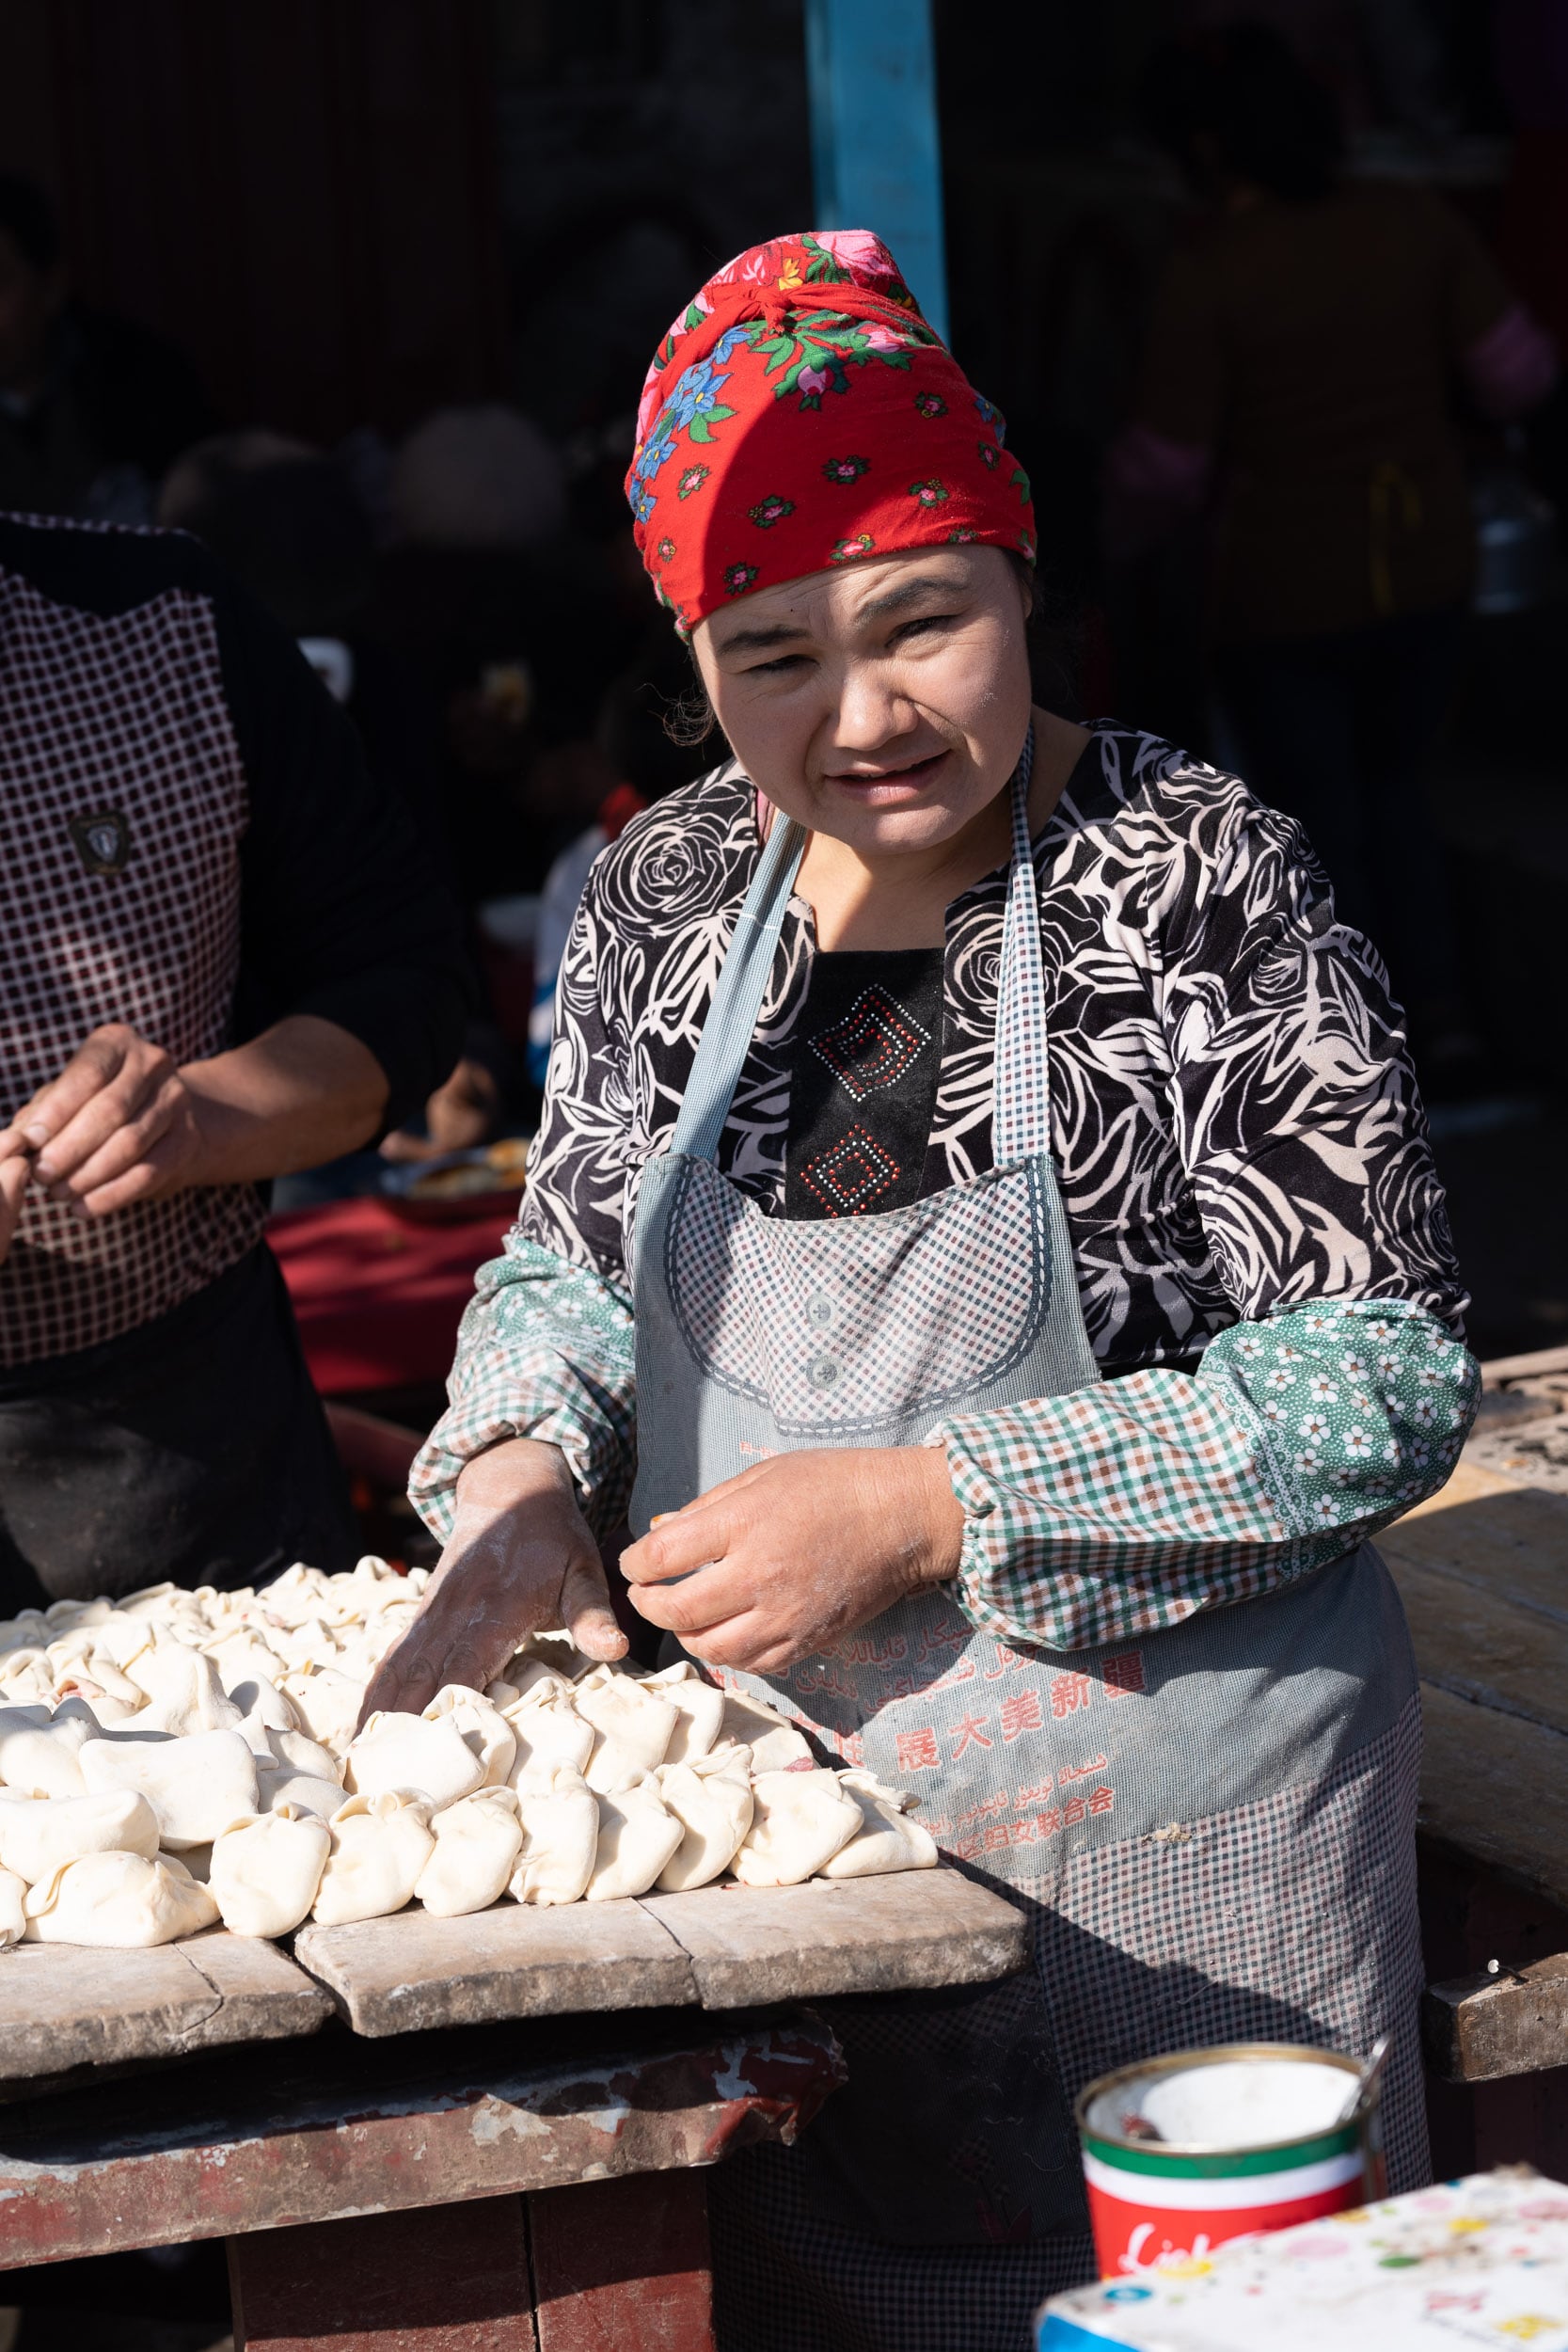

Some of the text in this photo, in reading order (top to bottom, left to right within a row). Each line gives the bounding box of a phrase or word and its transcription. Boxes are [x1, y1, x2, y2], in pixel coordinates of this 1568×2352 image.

[895, 1651, 1146, 1772] 展大美新疆
